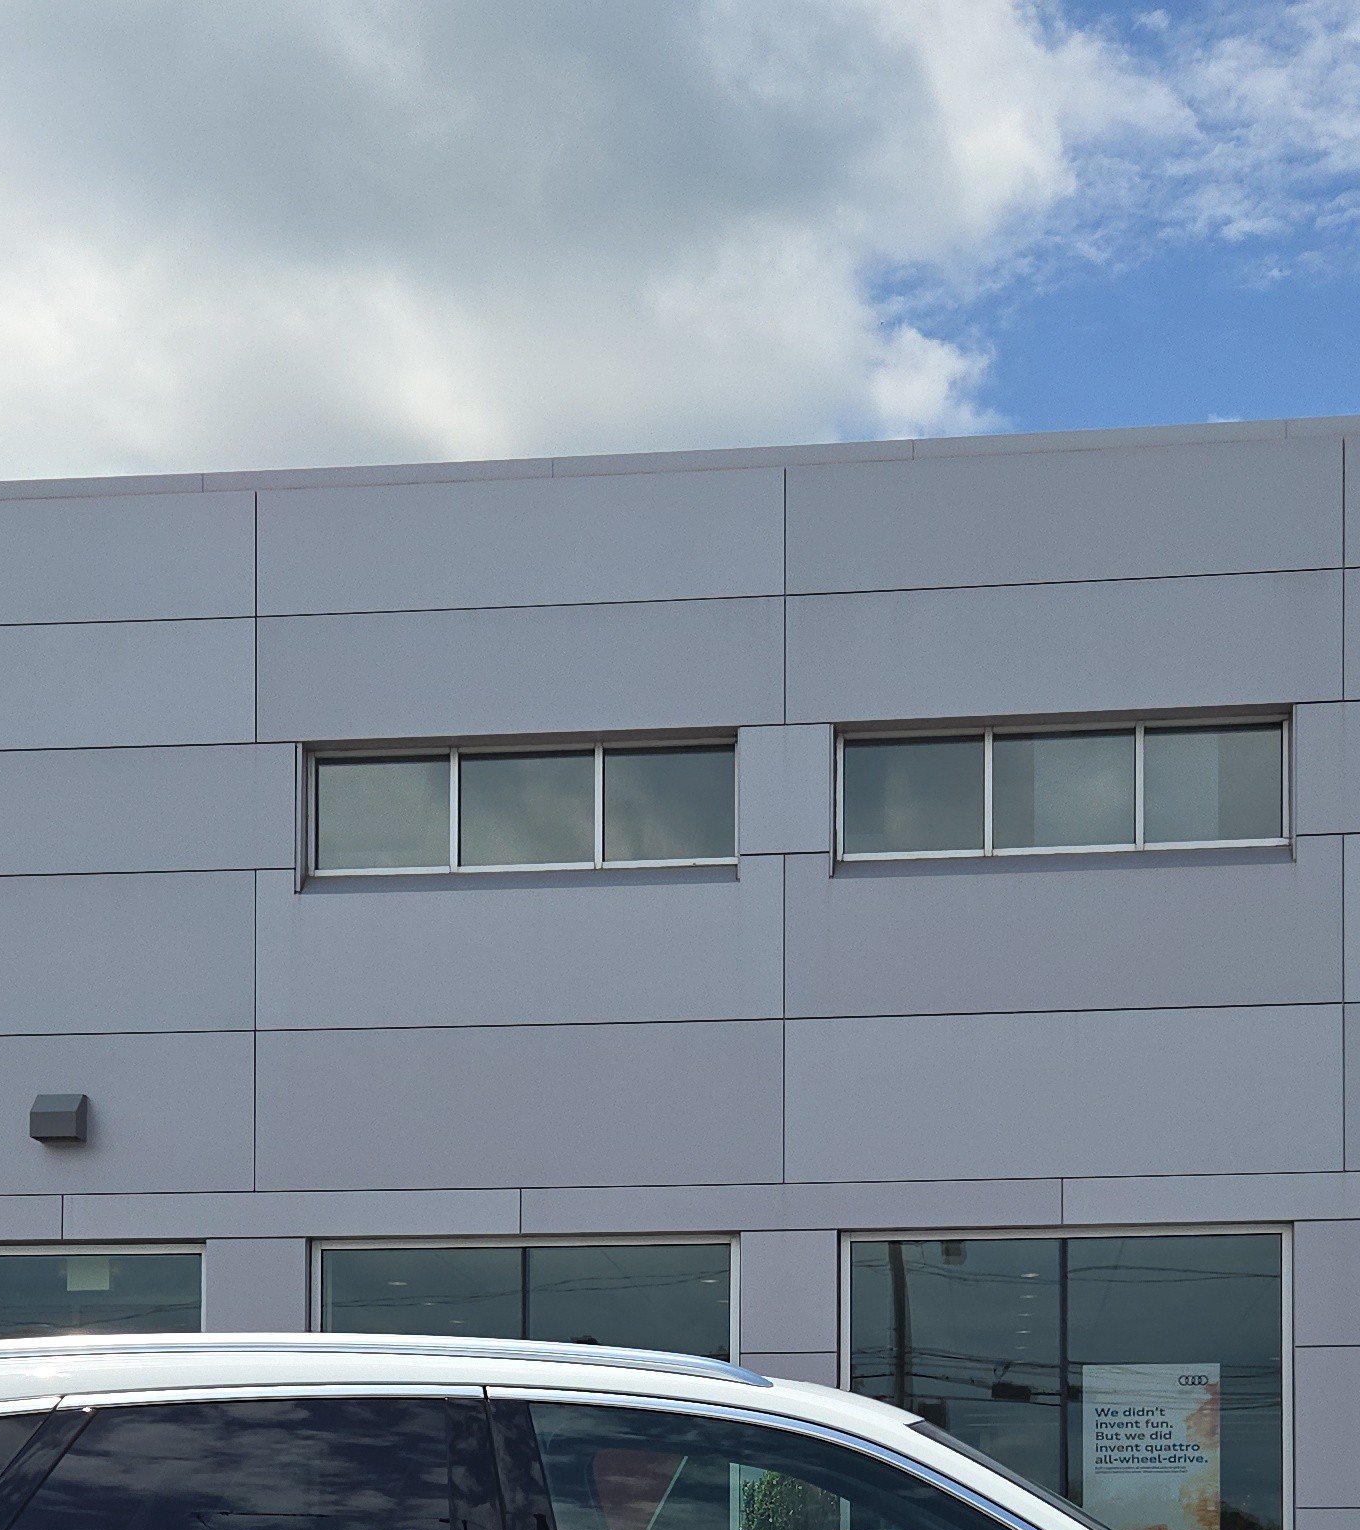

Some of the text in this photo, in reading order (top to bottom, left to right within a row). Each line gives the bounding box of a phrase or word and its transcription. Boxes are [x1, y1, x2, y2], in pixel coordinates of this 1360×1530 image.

[1095, 1406, 1166, 1417] We didn't
[1095, 1418, 1173, 1429] invent fun.
[1095, 1430, 1172, 1441] But we did
[1095, 1442, 1201, 1454] invent quattro
[1095, 1453, 1208, 1464] all-wheel-drive.
